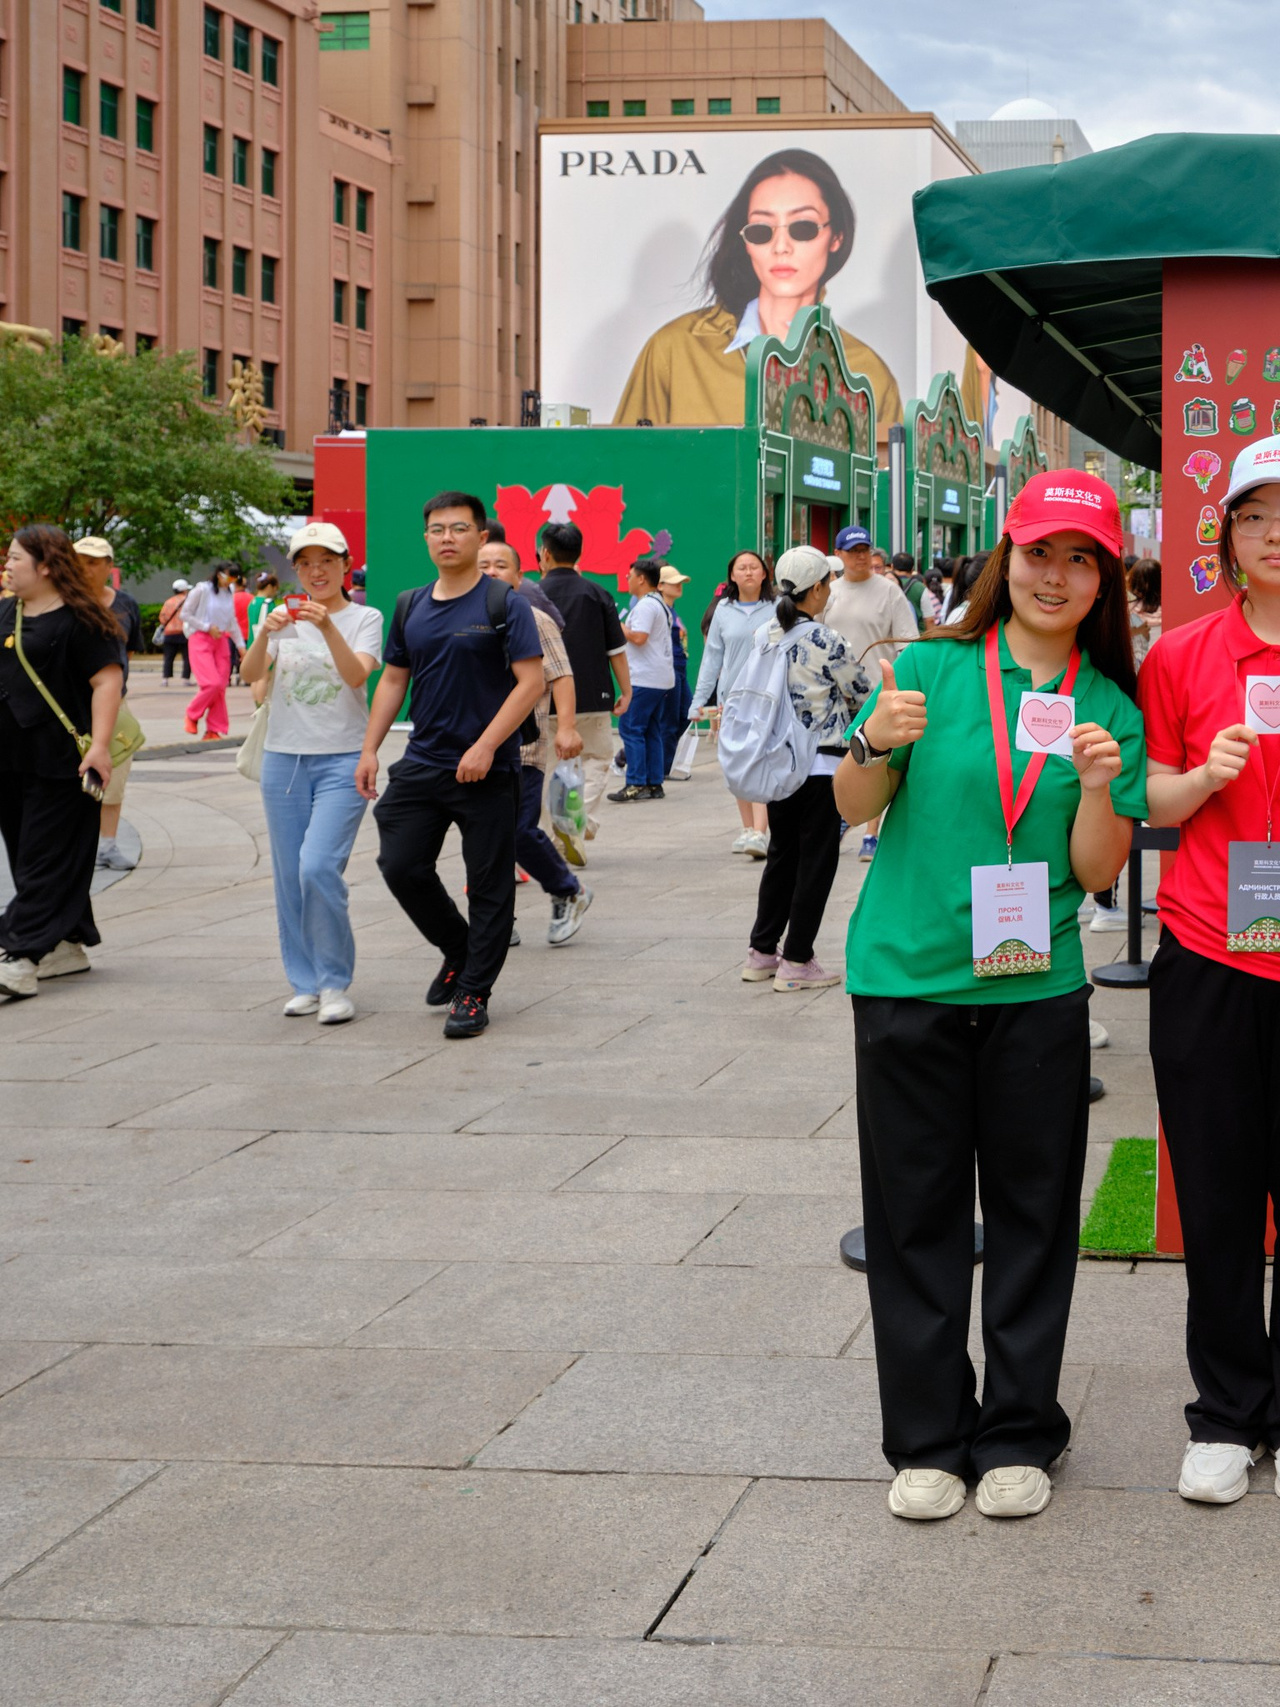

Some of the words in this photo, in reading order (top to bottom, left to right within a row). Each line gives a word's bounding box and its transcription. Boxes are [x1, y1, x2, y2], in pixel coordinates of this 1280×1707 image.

[559, 149, 707, 176] PRADA
[1045, 487, 1102, 503] 莫斯科文化节
[1254, 893, 1280, 901] 行政人员
[998, 914, 1023, 923] 促销人员
